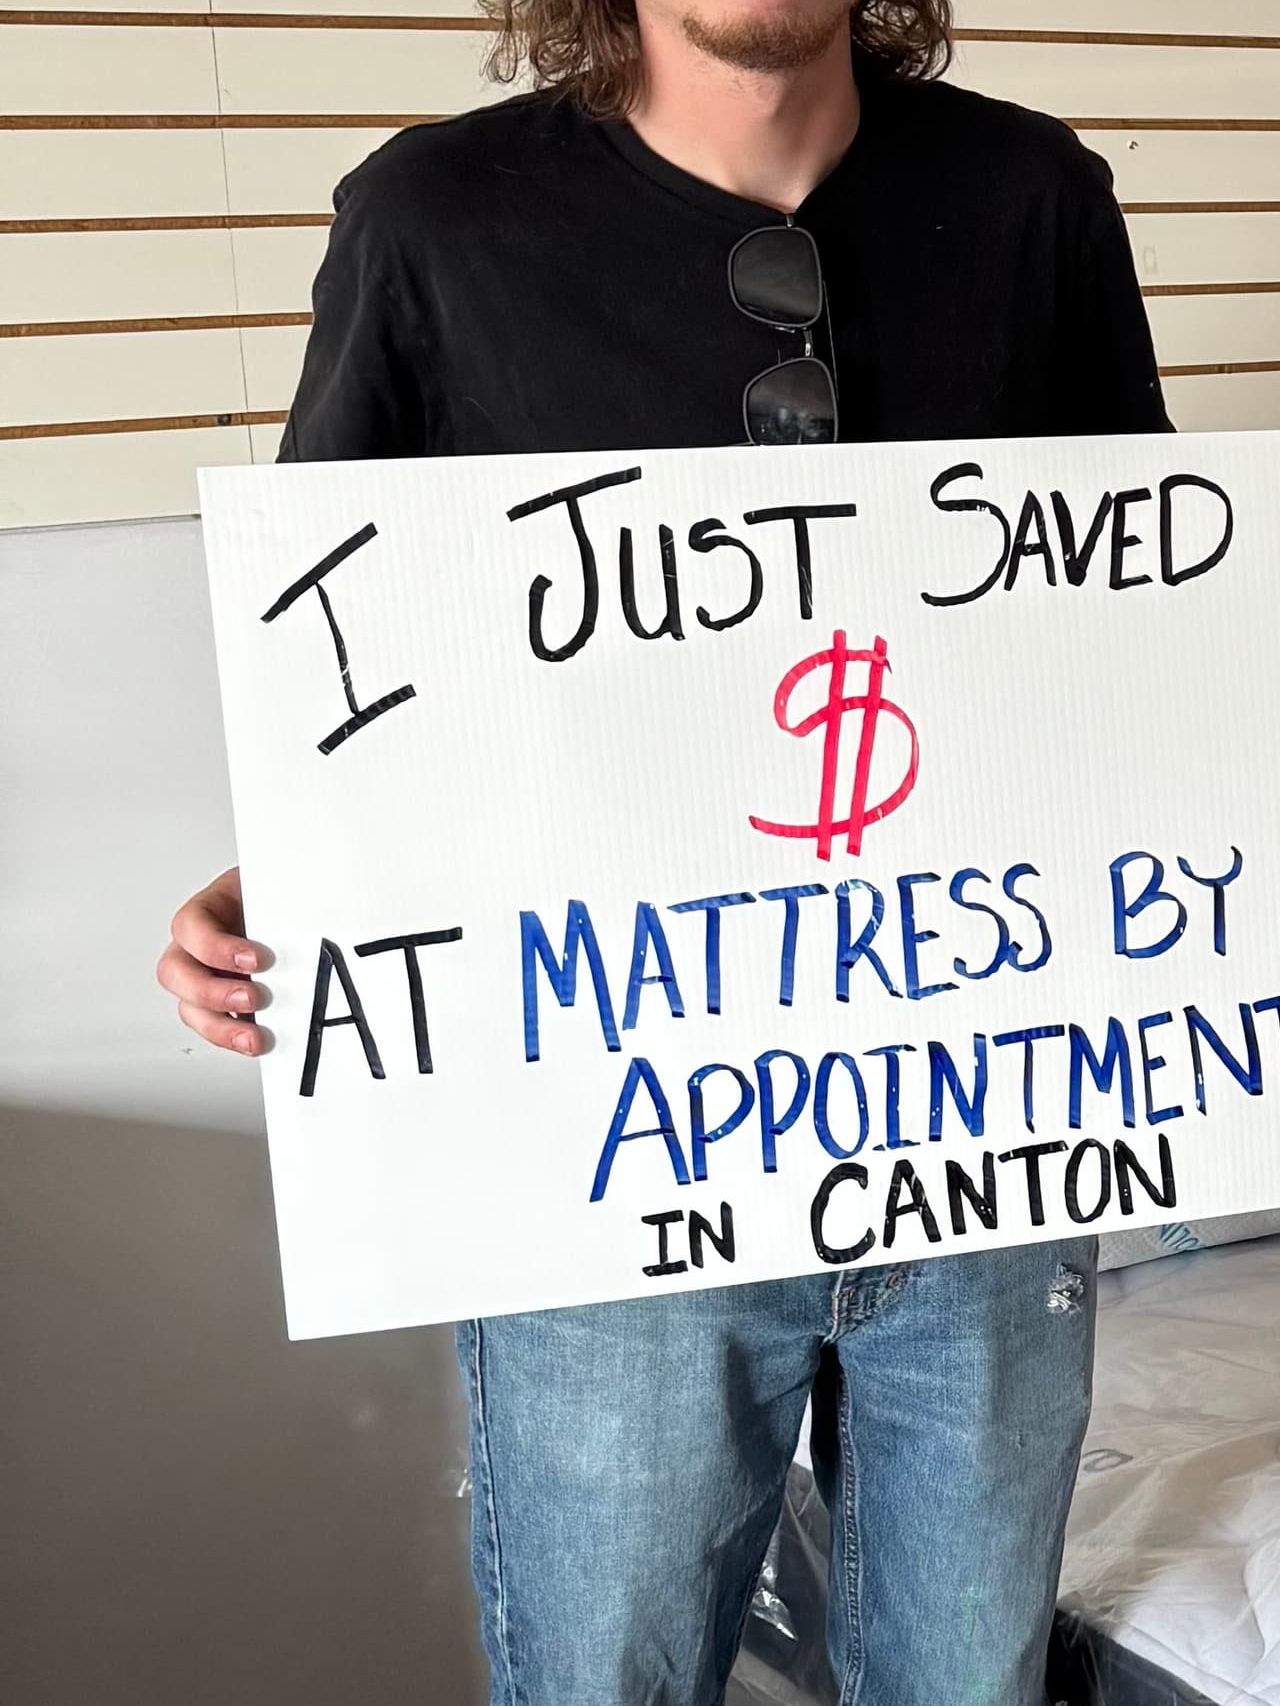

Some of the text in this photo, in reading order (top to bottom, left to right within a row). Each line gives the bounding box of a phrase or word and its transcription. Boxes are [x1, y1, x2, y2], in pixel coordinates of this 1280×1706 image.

[261, 463, 1233, 755] I JUST SAVED
[749, 630, 919, 861] $
[299, 846, 1242, 1097] AT MATTRESS BY
[642, 1132, 1182, 1276] IN CANTON
